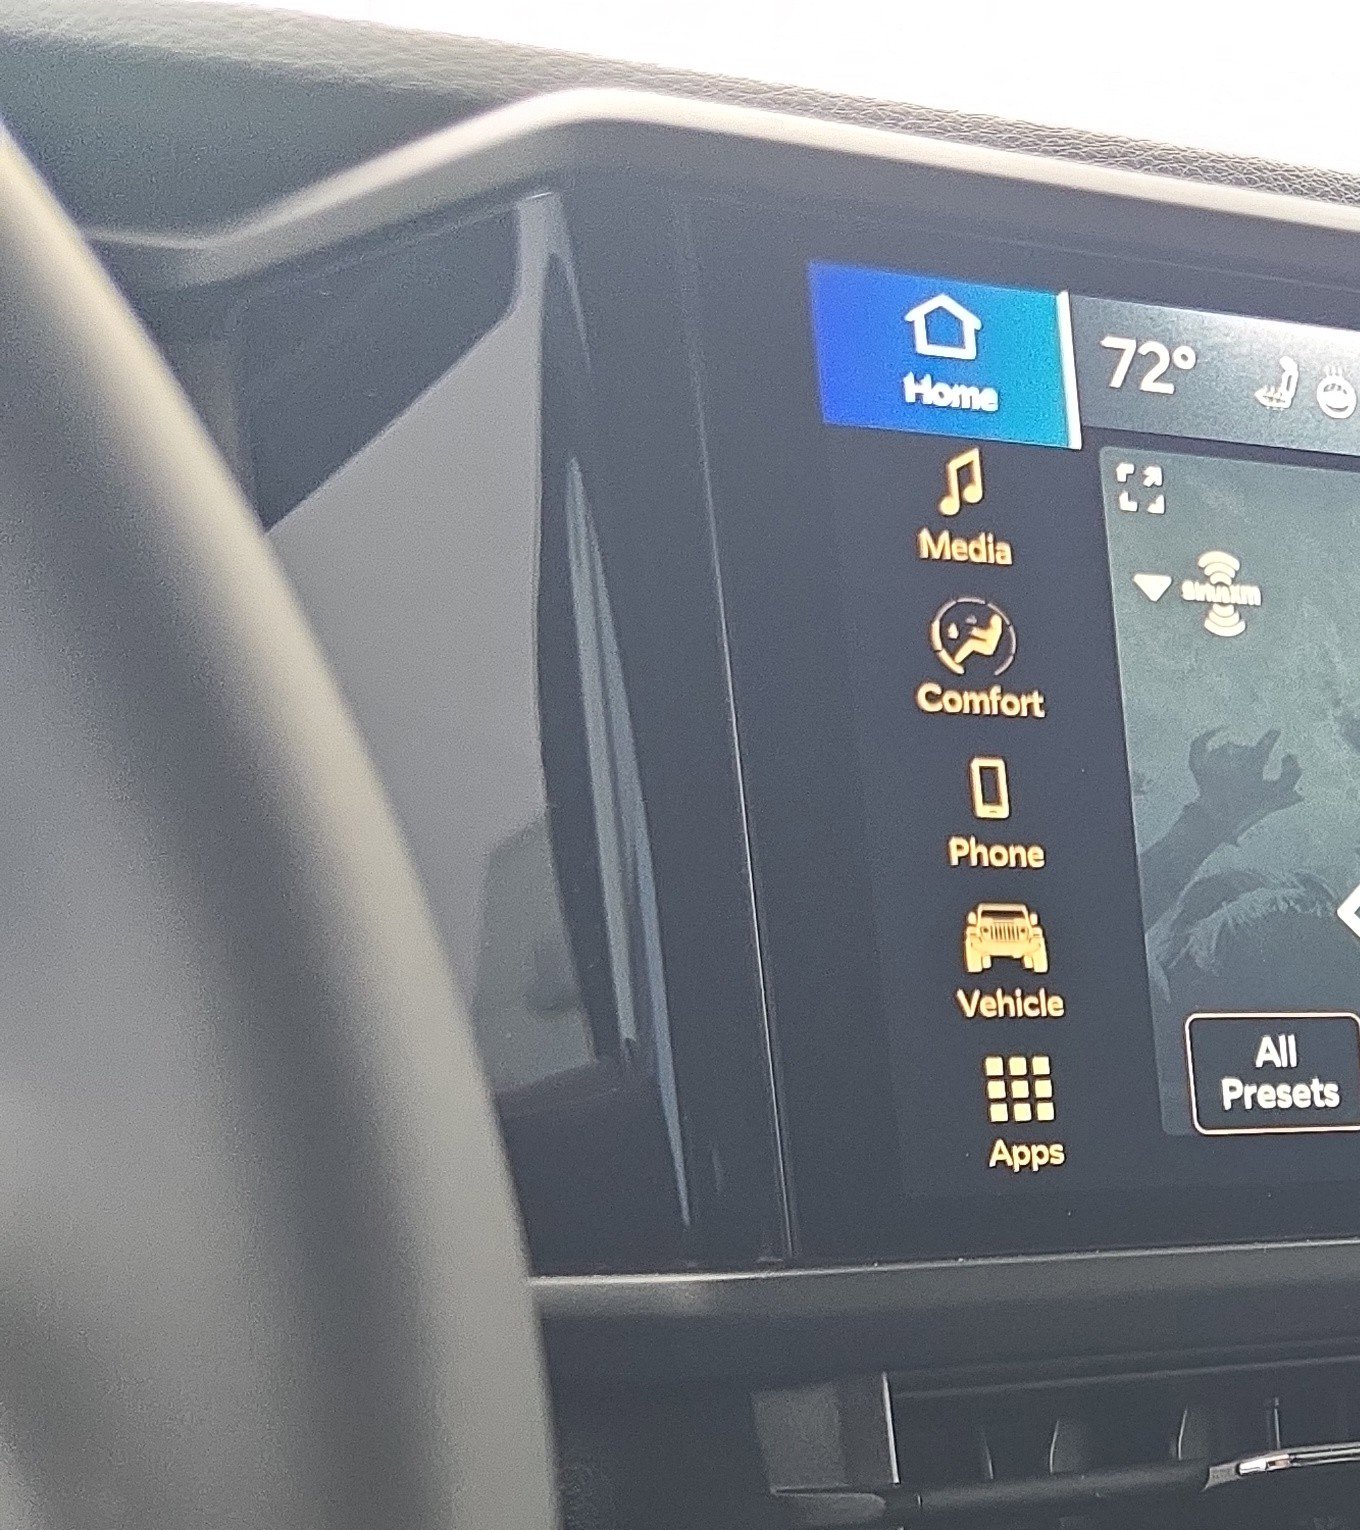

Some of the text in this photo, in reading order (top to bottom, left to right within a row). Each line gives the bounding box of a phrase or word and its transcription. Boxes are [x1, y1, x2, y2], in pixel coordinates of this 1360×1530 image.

[1101, 337, 1195, 396] 72°
[904, 371, 998, 412] Home
[918, 528, 1012, 567] Media
[917, 682, 1046, 719] Comfort
[949, 837, 1045, 868] Phone
[956, 989, 1065, 1018] Vehicle
[1255, 1035, 1297, 1068] All
[1222, 1077, 1339, 1111] Presets
[988, 1139, 1065, 1172] Apps
